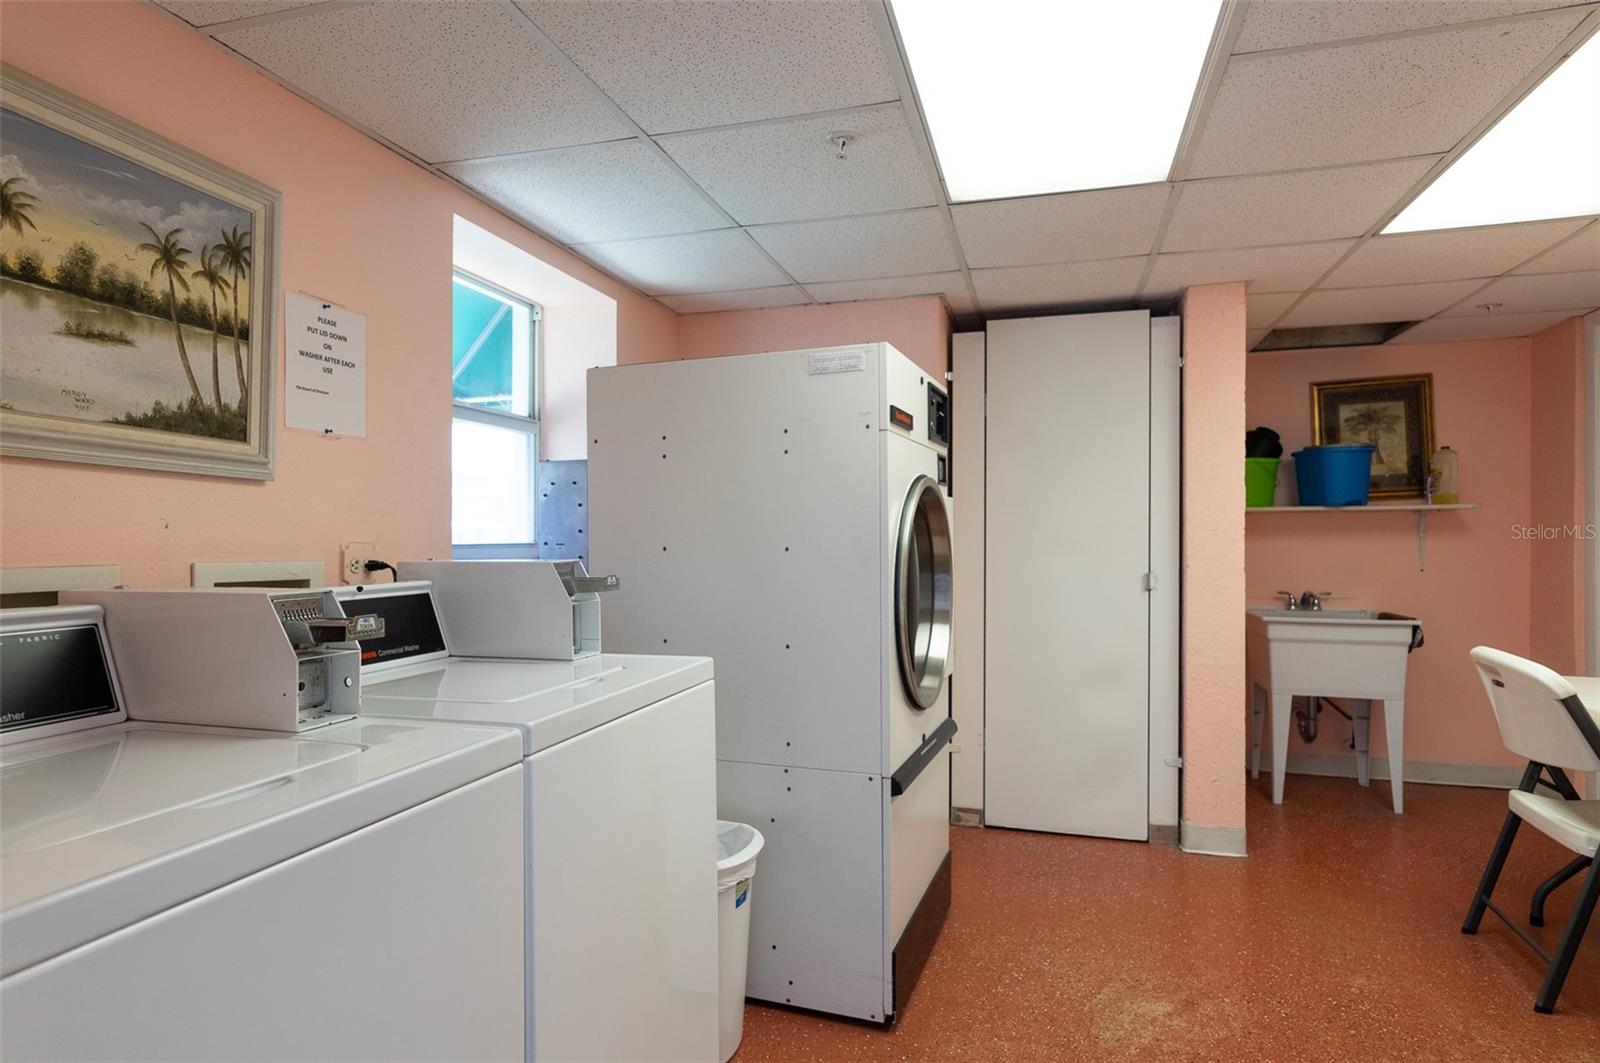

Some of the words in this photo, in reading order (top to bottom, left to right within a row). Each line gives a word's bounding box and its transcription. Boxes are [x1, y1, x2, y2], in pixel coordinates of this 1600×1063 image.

[317, 316, 337, 327] PLEASE
[307, 326, 318, 334] PUT
[319, 329, 328, 337] LID
[329, 332, 347, 342] DOWN
[323, 343, 332, 351] ON
[298, 350, 323, 361] WASHER
[324, 355, 341, 365] AFTER
[341, 359, 356, 369] EACH
[19, 634, 60, 642] FABRIC
